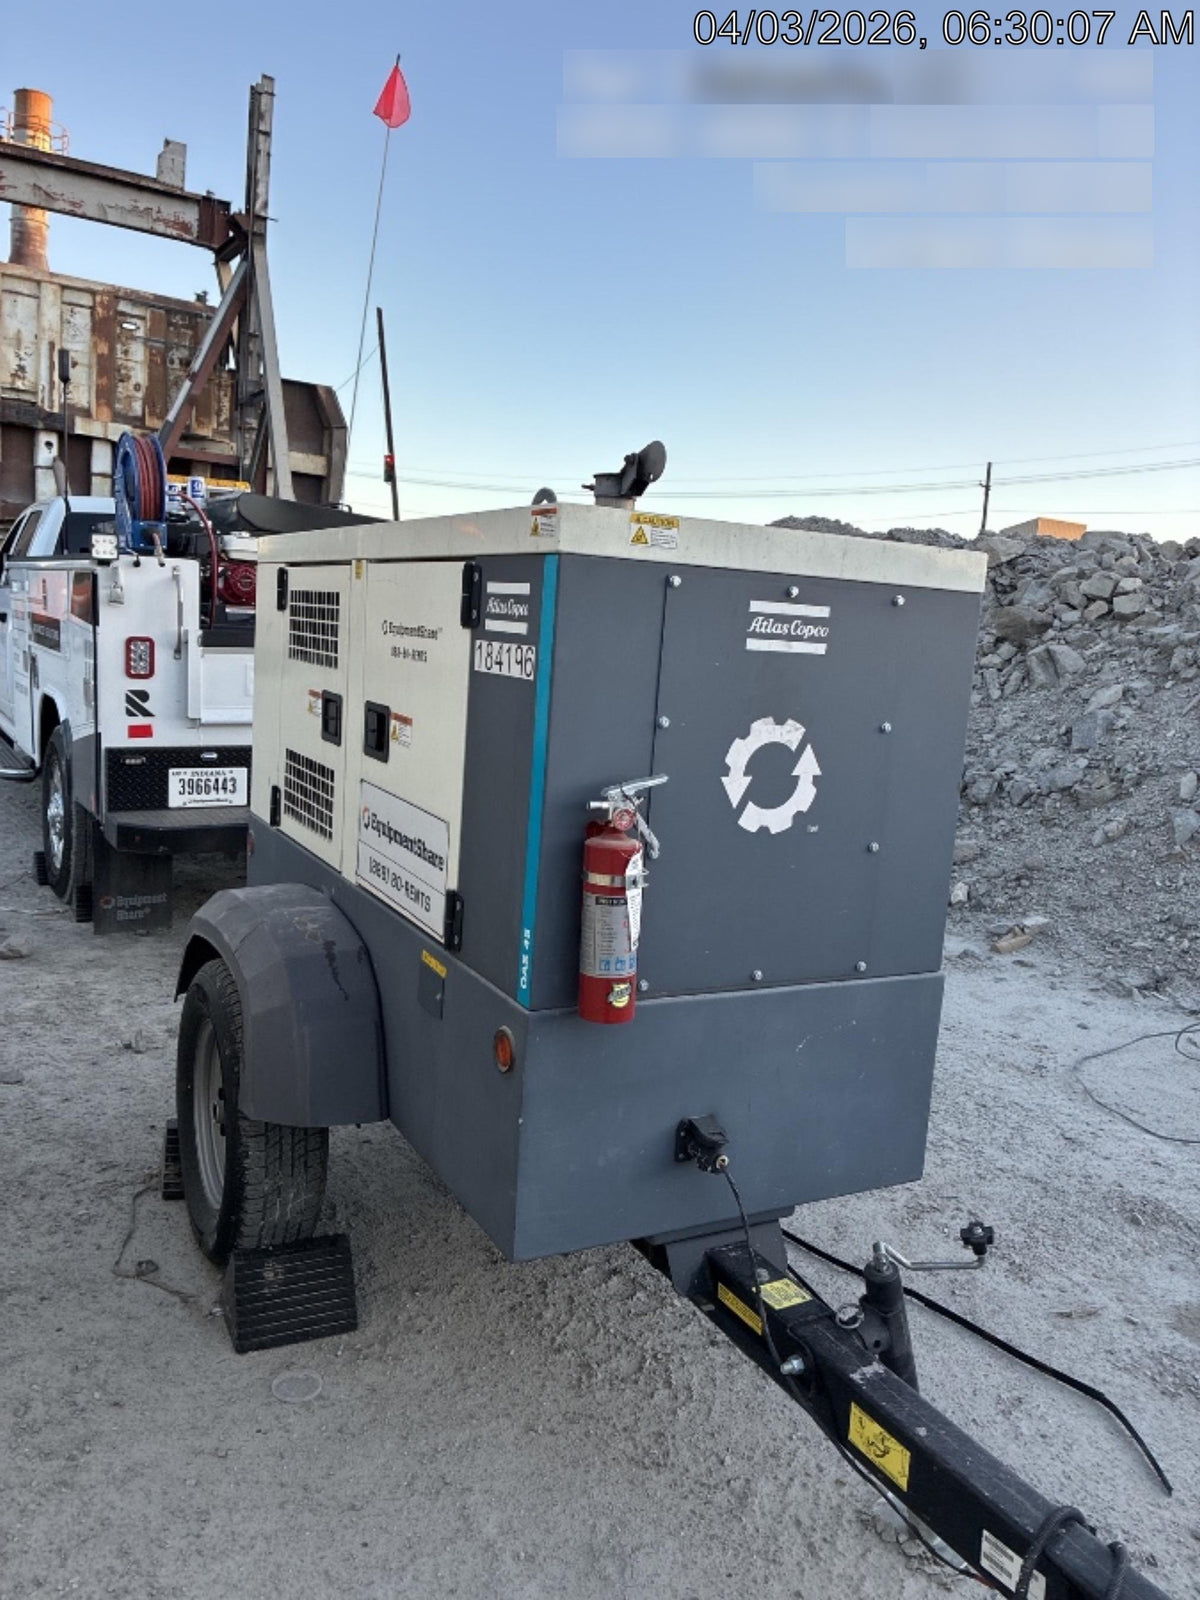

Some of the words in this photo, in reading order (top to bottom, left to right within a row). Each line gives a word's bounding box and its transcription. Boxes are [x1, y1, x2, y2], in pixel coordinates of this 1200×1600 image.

[746, 616, 790, 636] Atlas
[791, 619, 830, 640] Copco
[477, 641, 535, 677] 184196
[178, 776, 237, 796] 3966443
[370, 812, 445, 872] EquipmentShare
